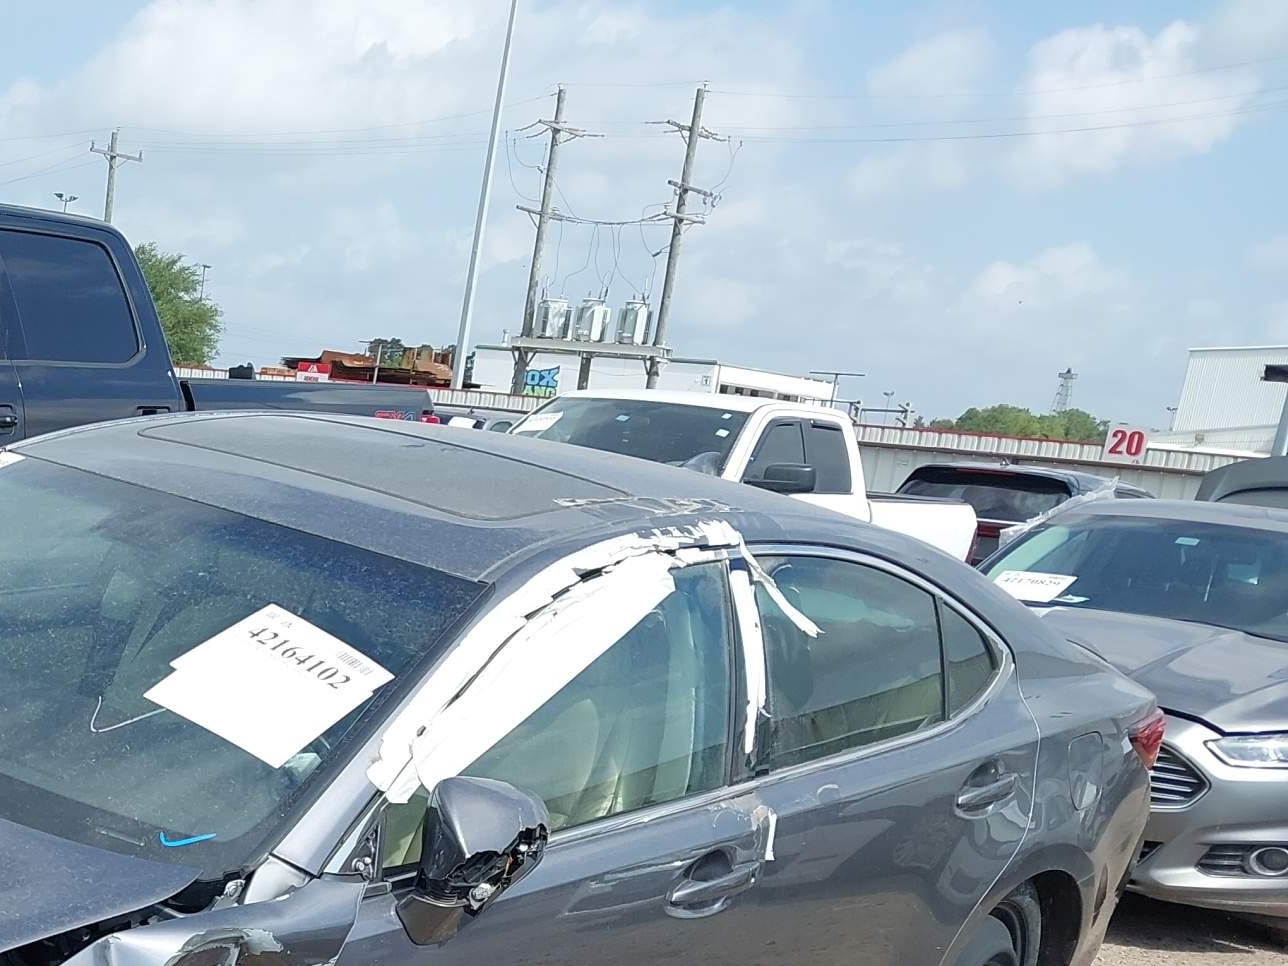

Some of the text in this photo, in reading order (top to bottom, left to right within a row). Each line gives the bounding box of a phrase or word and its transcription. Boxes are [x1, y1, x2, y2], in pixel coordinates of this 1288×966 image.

[524, 367, 560, 387] OX
[1108, 429, 1145, 456] 20
[247, 626, 351, 690] 42164102
